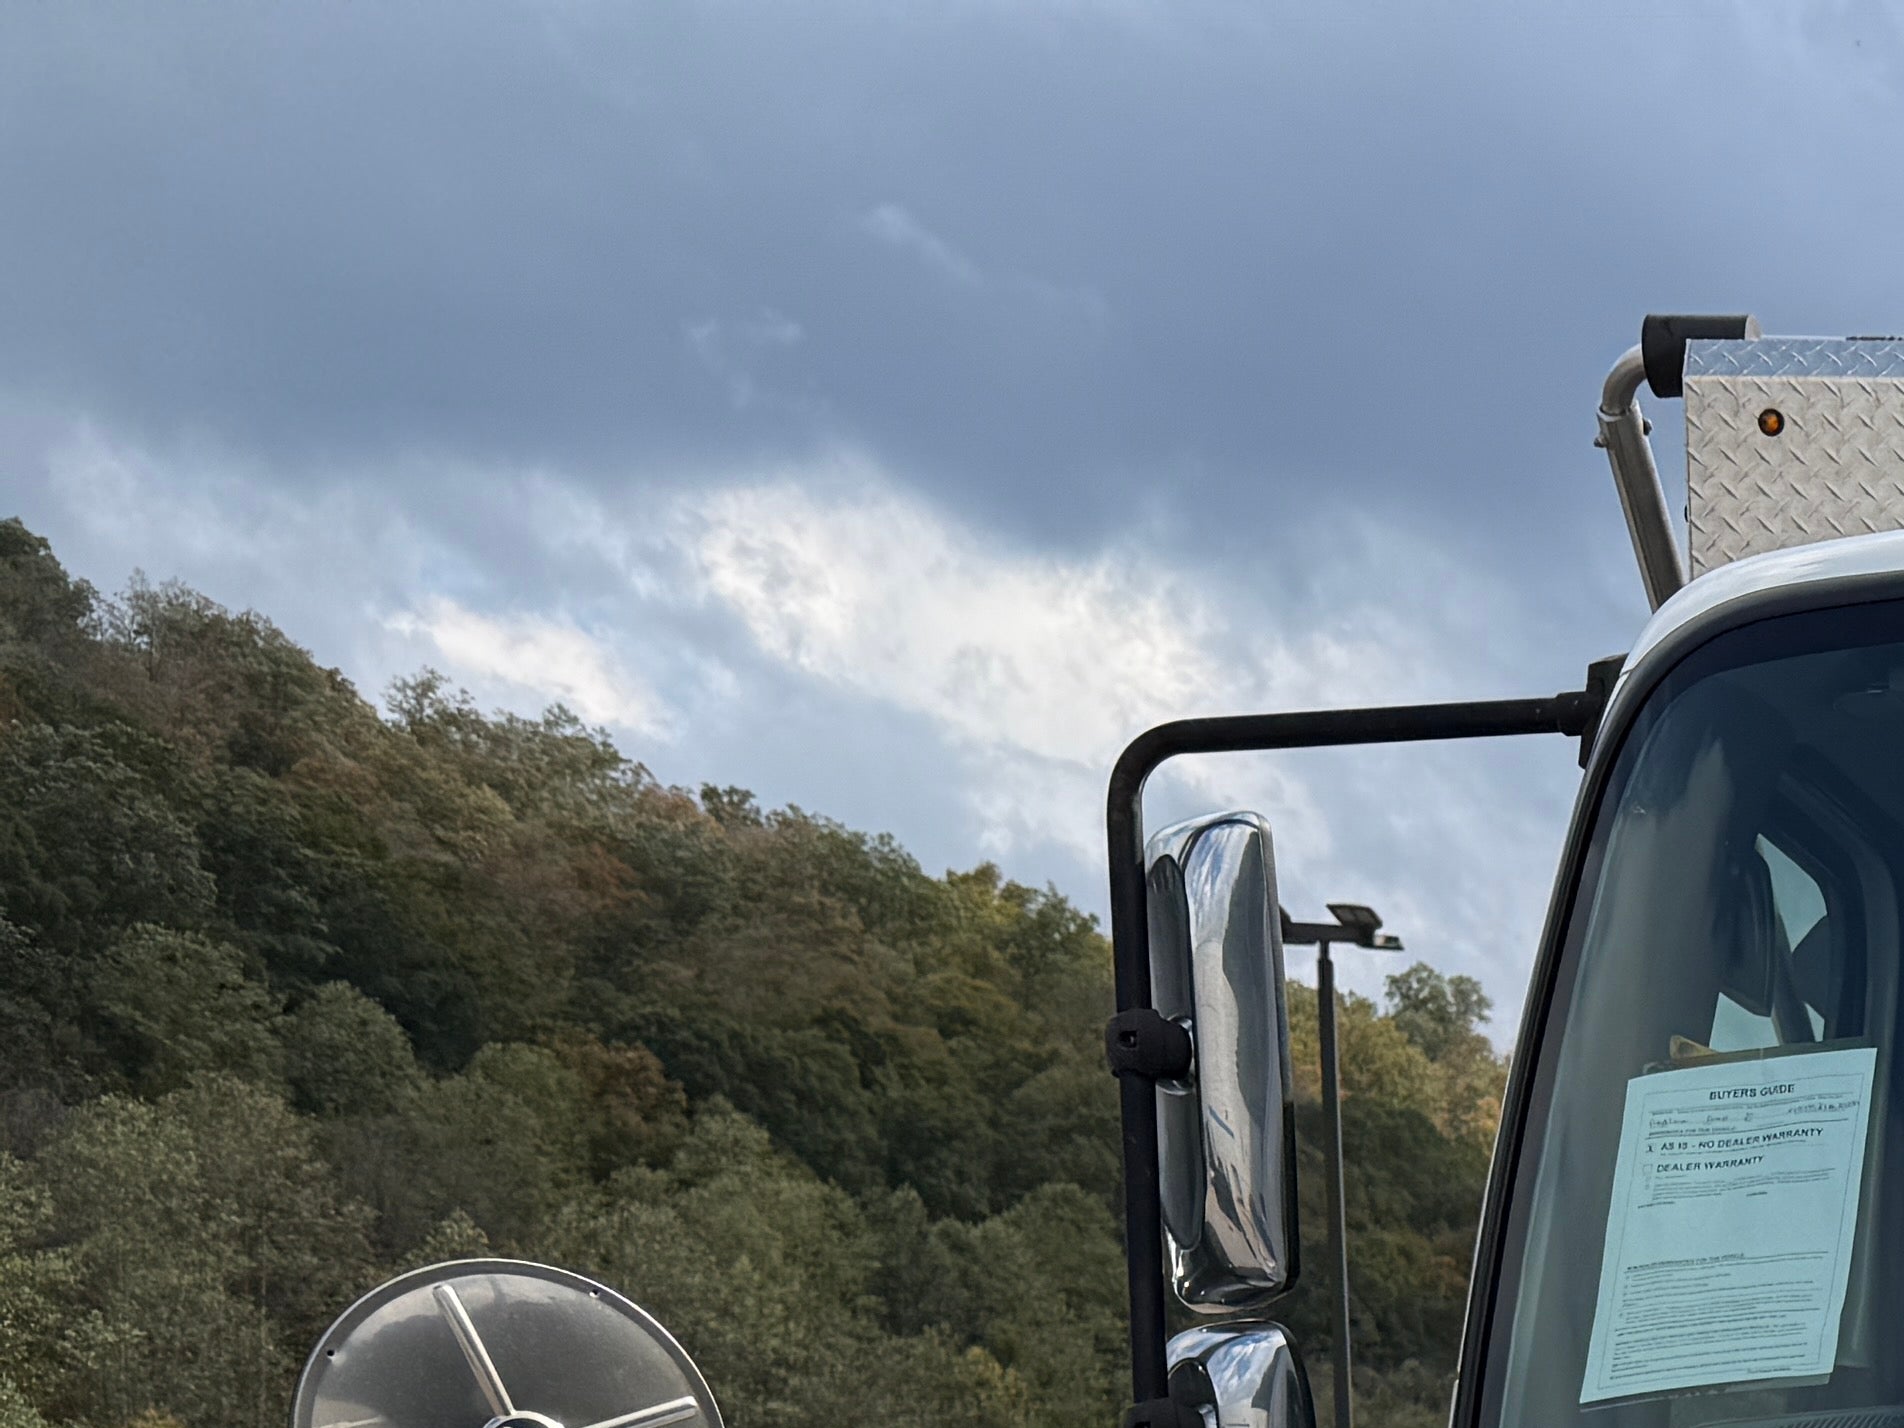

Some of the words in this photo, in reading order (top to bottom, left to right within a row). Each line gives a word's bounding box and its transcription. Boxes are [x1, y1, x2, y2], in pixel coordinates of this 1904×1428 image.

[1709, 1086, 1758, 1101] BUYERS
[1760, 1083, 1796, 1097] GUIDE
[1762, 1127, 1825, 1144] WARRANTY
[1656, 1160, 1701, 1174] DEALER
[1704, 1155, 1765, 1171] WARRANTY
